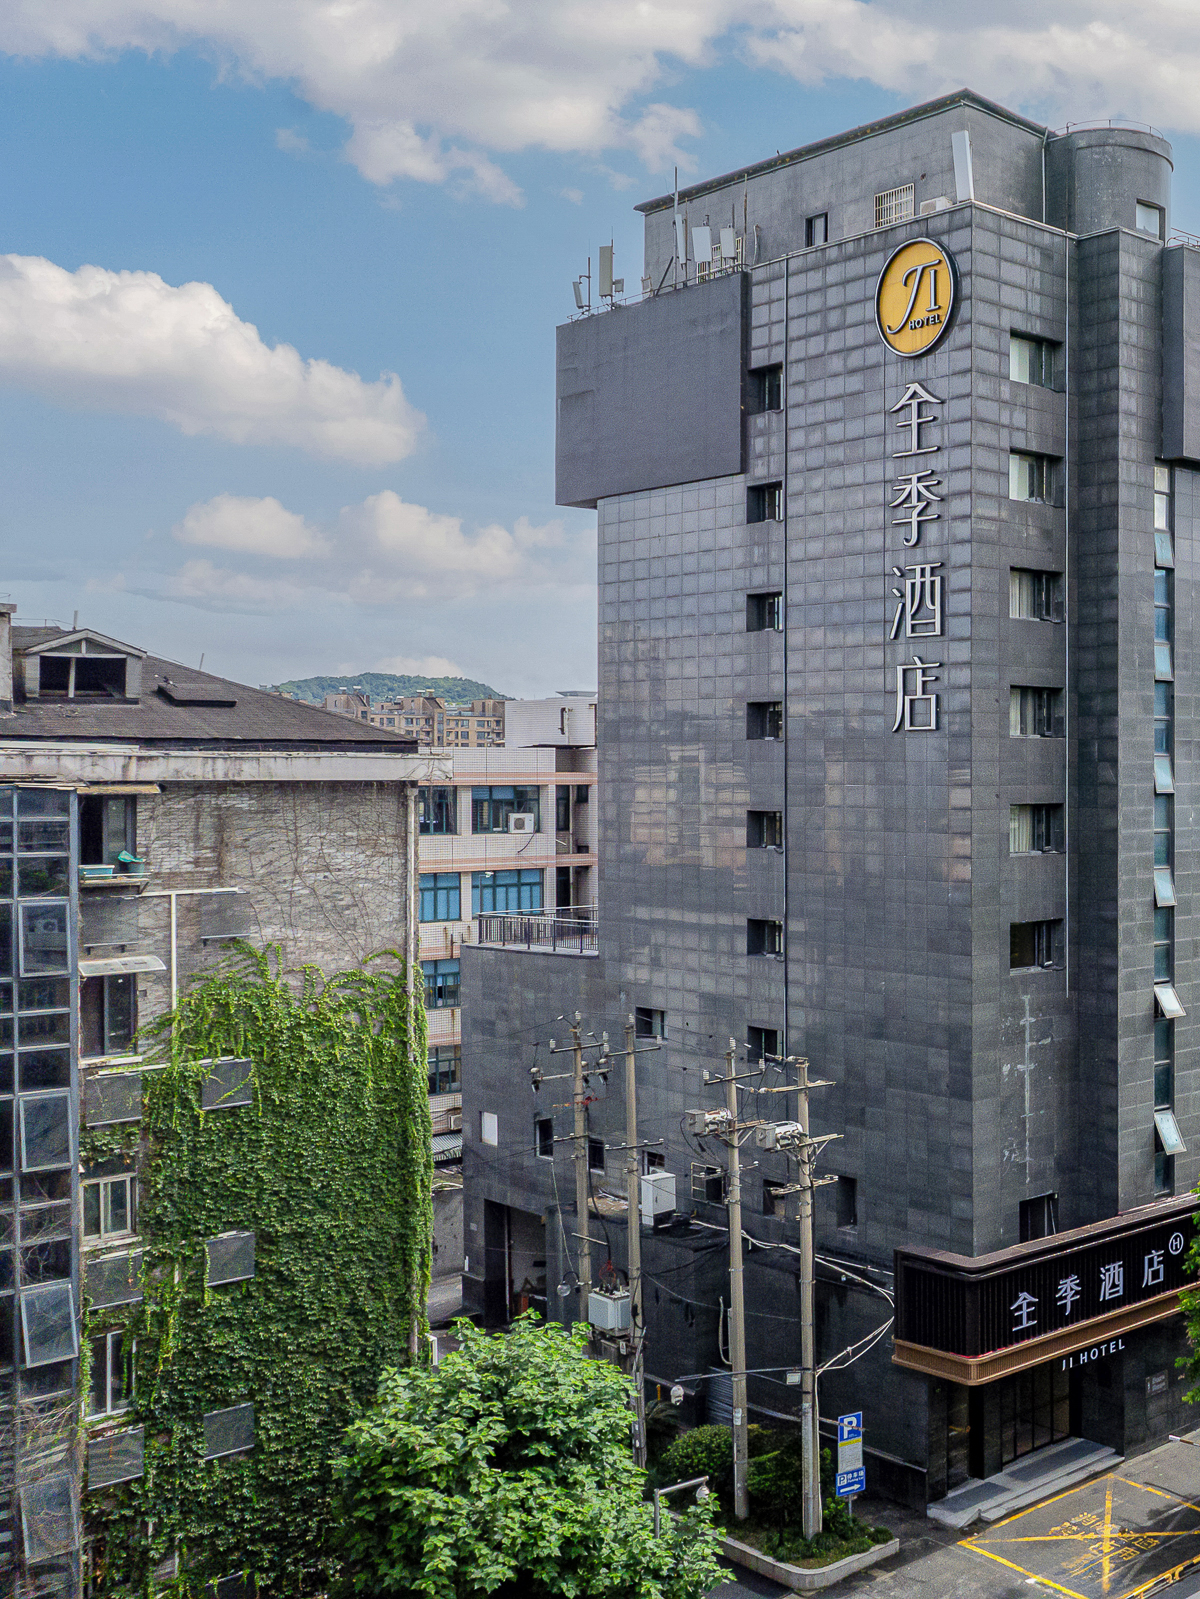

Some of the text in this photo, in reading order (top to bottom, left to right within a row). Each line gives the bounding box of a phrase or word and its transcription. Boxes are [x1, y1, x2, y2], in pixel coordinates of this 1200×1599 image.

[908, 313, 941, 331] HOTEL
[889, 382, 943, 732] 全季酒店
[1010, 1249, 1165, 1332] 全季酒店
[1062, 1339, 1125, 1371] JI HOTEL
[843, 1417, 857, 1439] P
